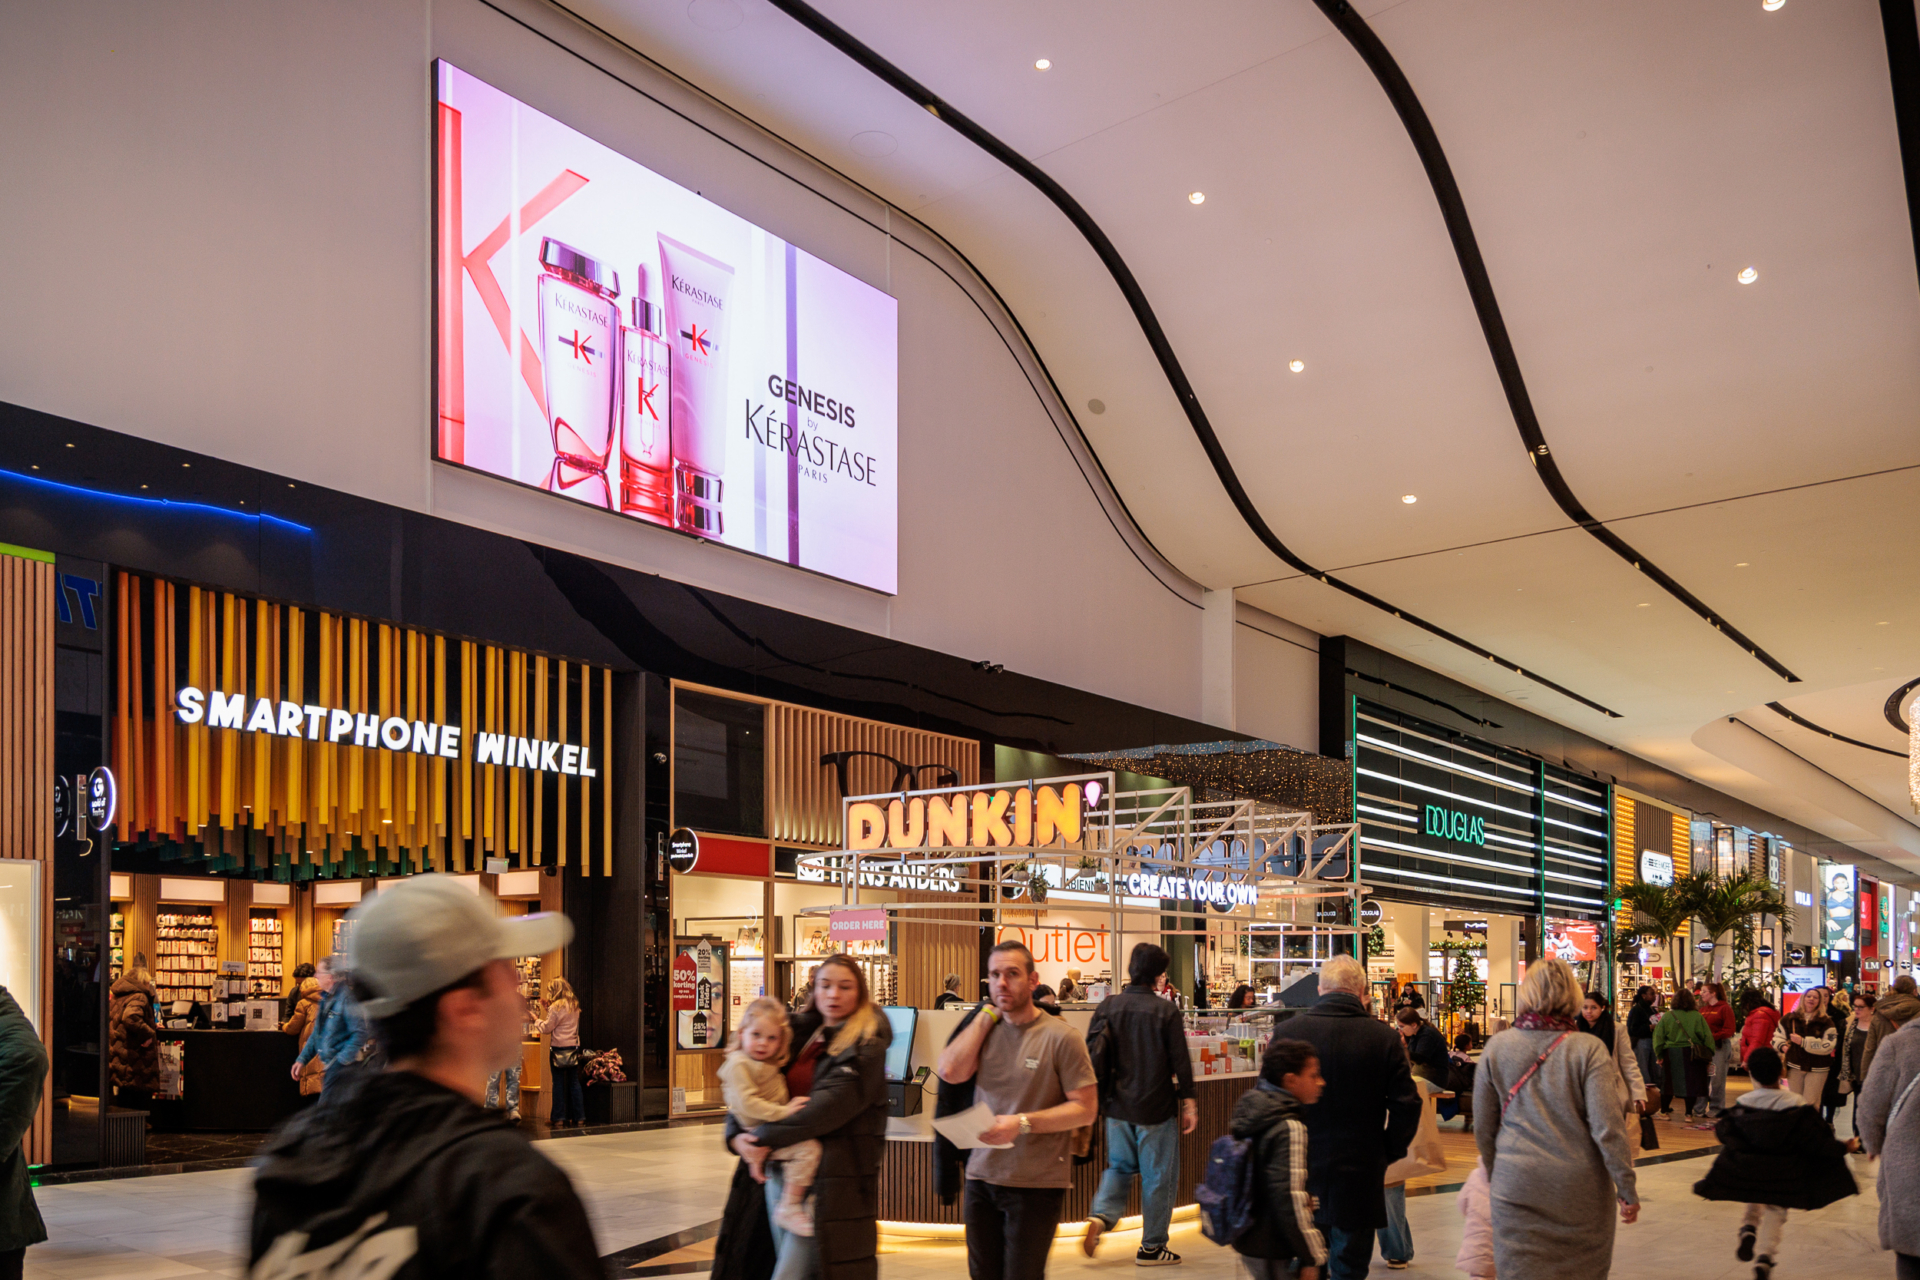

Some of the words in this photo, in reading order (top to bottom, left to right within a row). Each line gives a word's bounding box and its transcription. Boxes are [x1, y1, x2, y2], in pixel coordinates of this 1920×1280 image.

[768, 374, 855, 428] GENESIS
[807, 416, 818, 431] by
[746, 398, 876, 487] KÉRASTASE
[798, 464, 828, 484] PARIS
[177, 686, 461, 759] SMARTPHONE
[477, 731, 596, 777] WINKEL
[1426, 804, 1485, 846] DOUGLAS
[889, 864, 960, 893] ANDERS
[1128, 872, 1186, 899] CREATE
[1188, 877, 1226, 902] YOUR
[1227, 883, 1258, 906] OWN
[831, 920, 860, 931] ORDER
[862, 919, 885, 930] HERE
[673, 969, 696, 982] 50%
[1865, 961, 1880, 970] LM
[673, 981, 695, 990] korting
